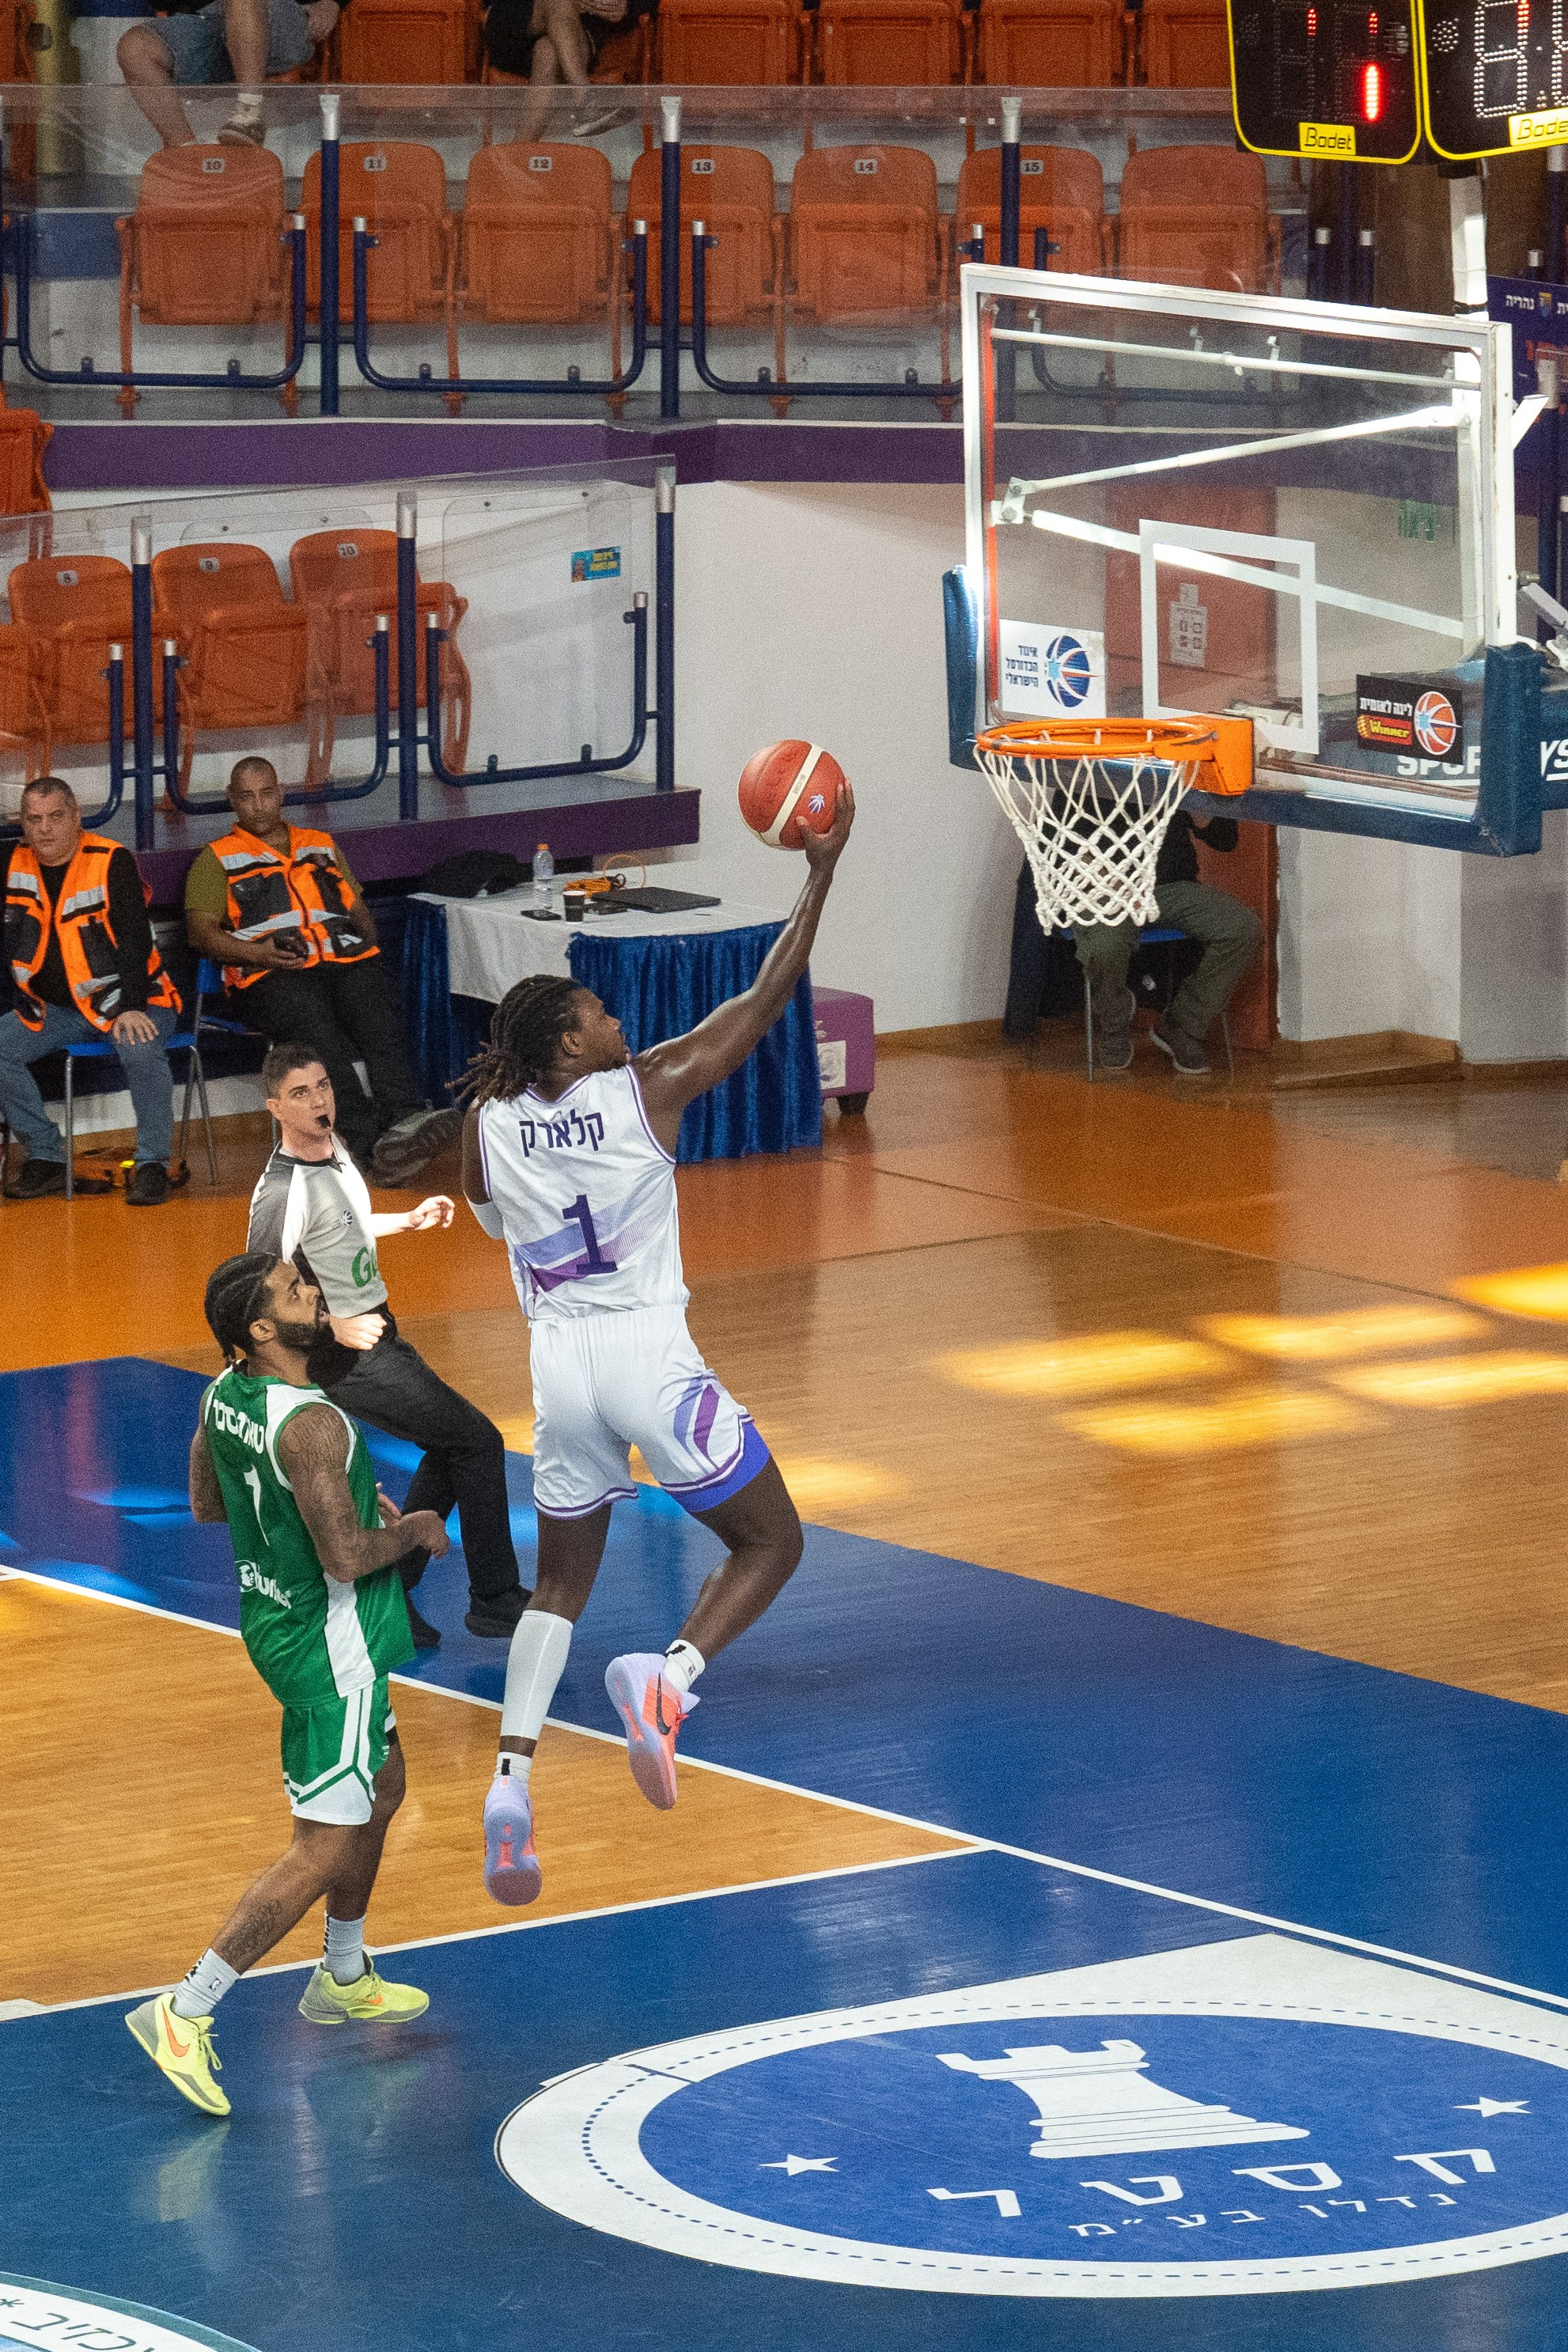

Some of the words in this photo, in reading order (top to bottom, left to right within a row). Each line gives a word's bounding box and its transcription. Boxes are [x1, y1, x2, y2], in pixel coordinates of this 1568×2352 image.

[1304, 127, 1352, 150] Bodet
[206, 161, 221, 170] 10
[368, 157, 382, 169] 11
[533, 158, 549, 169] 12
[695, 161, 711, 172] 13
[858, 161, 873, 172] 14
[1025, 162, 1040, 172] 15
[1506, 294, 1535, 310] נהריה
[1018, 645, 1038, 657] איגוד
[1006, 657, 1038, 672] הכדורסל
[1005, 672, 1039, 687] הישראלי
[519, 1108, 604, 1157] קלארק
[562, 1195, 618, 1274] 1
[926, 2149, 1496, 2217] קסטל
[9, 2312, 156, 2352] כזיב
